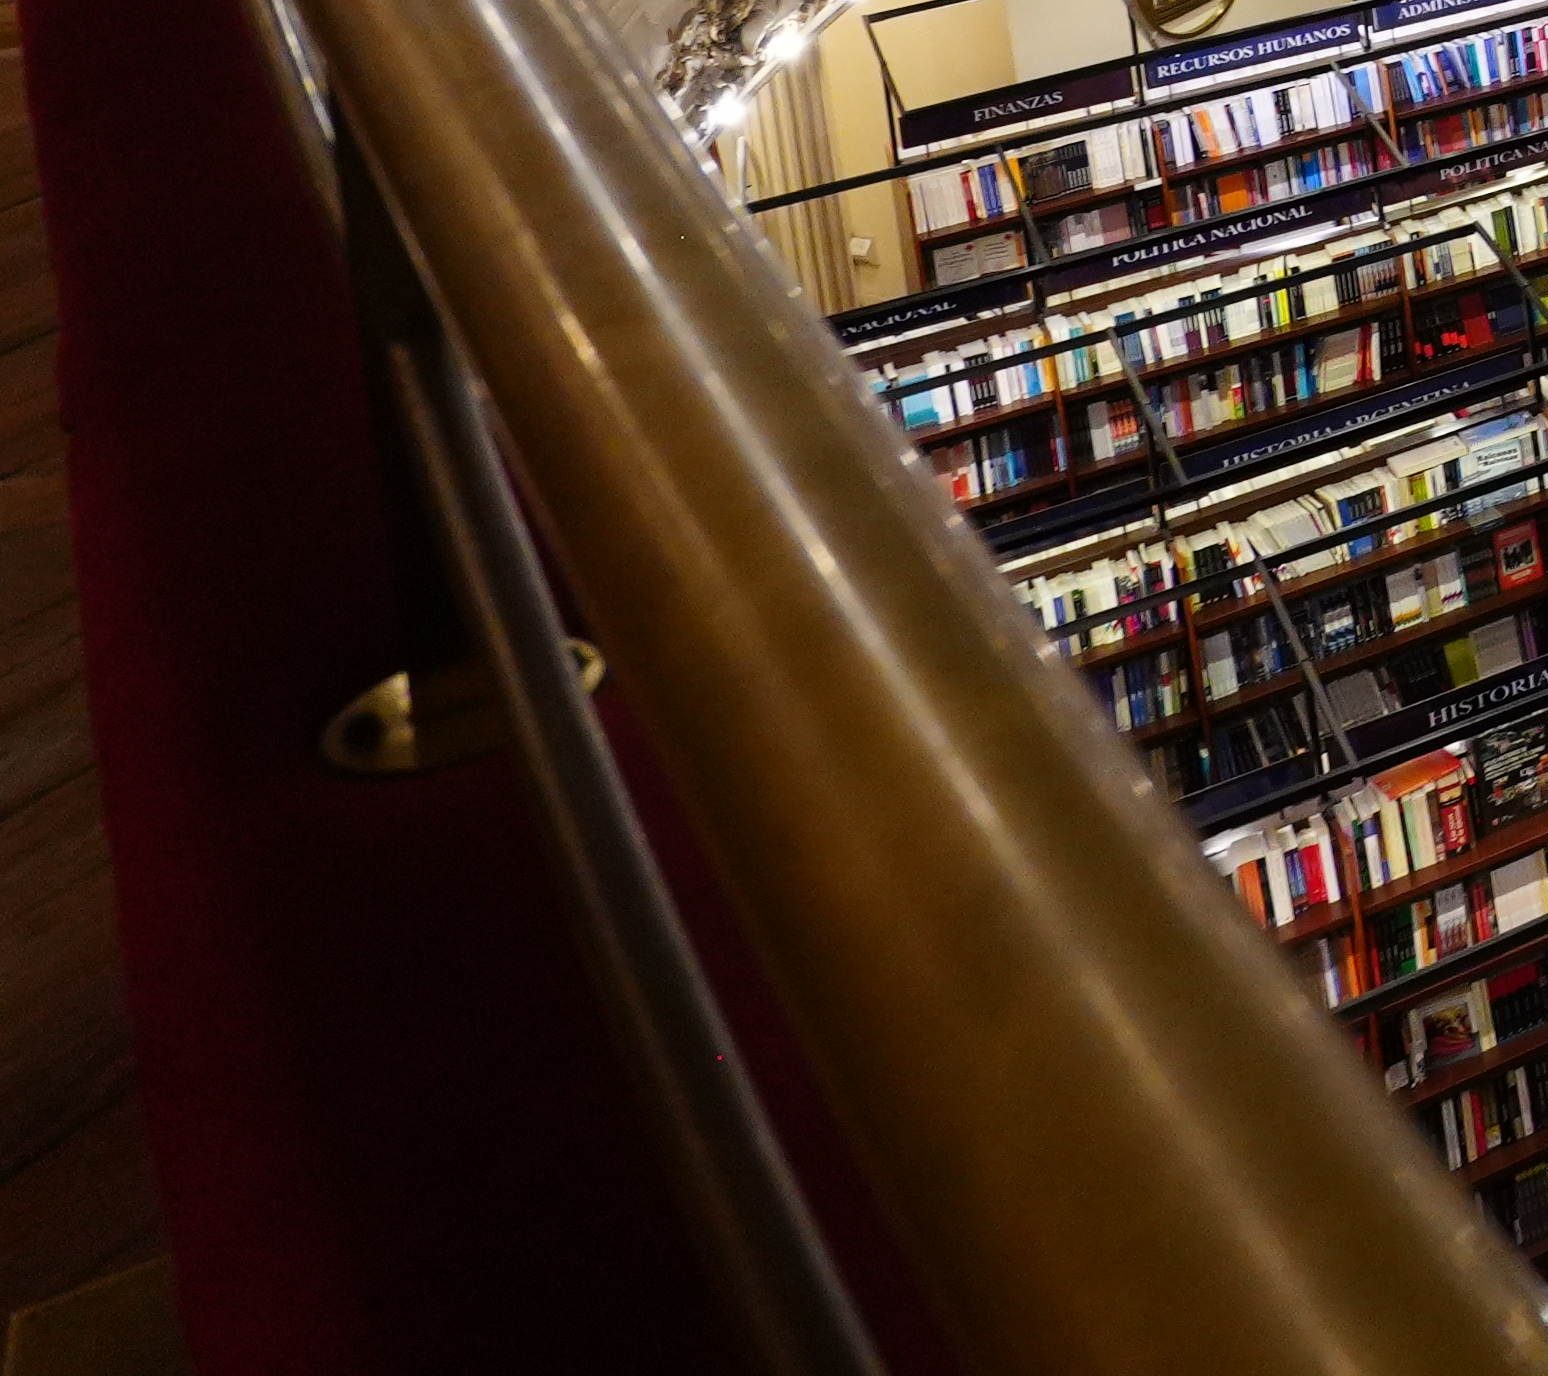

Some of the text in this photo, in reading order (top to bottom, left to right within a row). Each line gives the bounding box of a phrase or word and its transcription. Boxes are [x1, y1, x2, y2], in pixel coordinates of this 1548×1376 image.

[1156, 23, 1352, 80] RECURSOS HUMANOS
[973, 90, 1065, 123] FINANZAS
[1439, 148, 1524, 181] POLITICA
[1112, 204, 1314, 268] POLITICA NACIONAL
